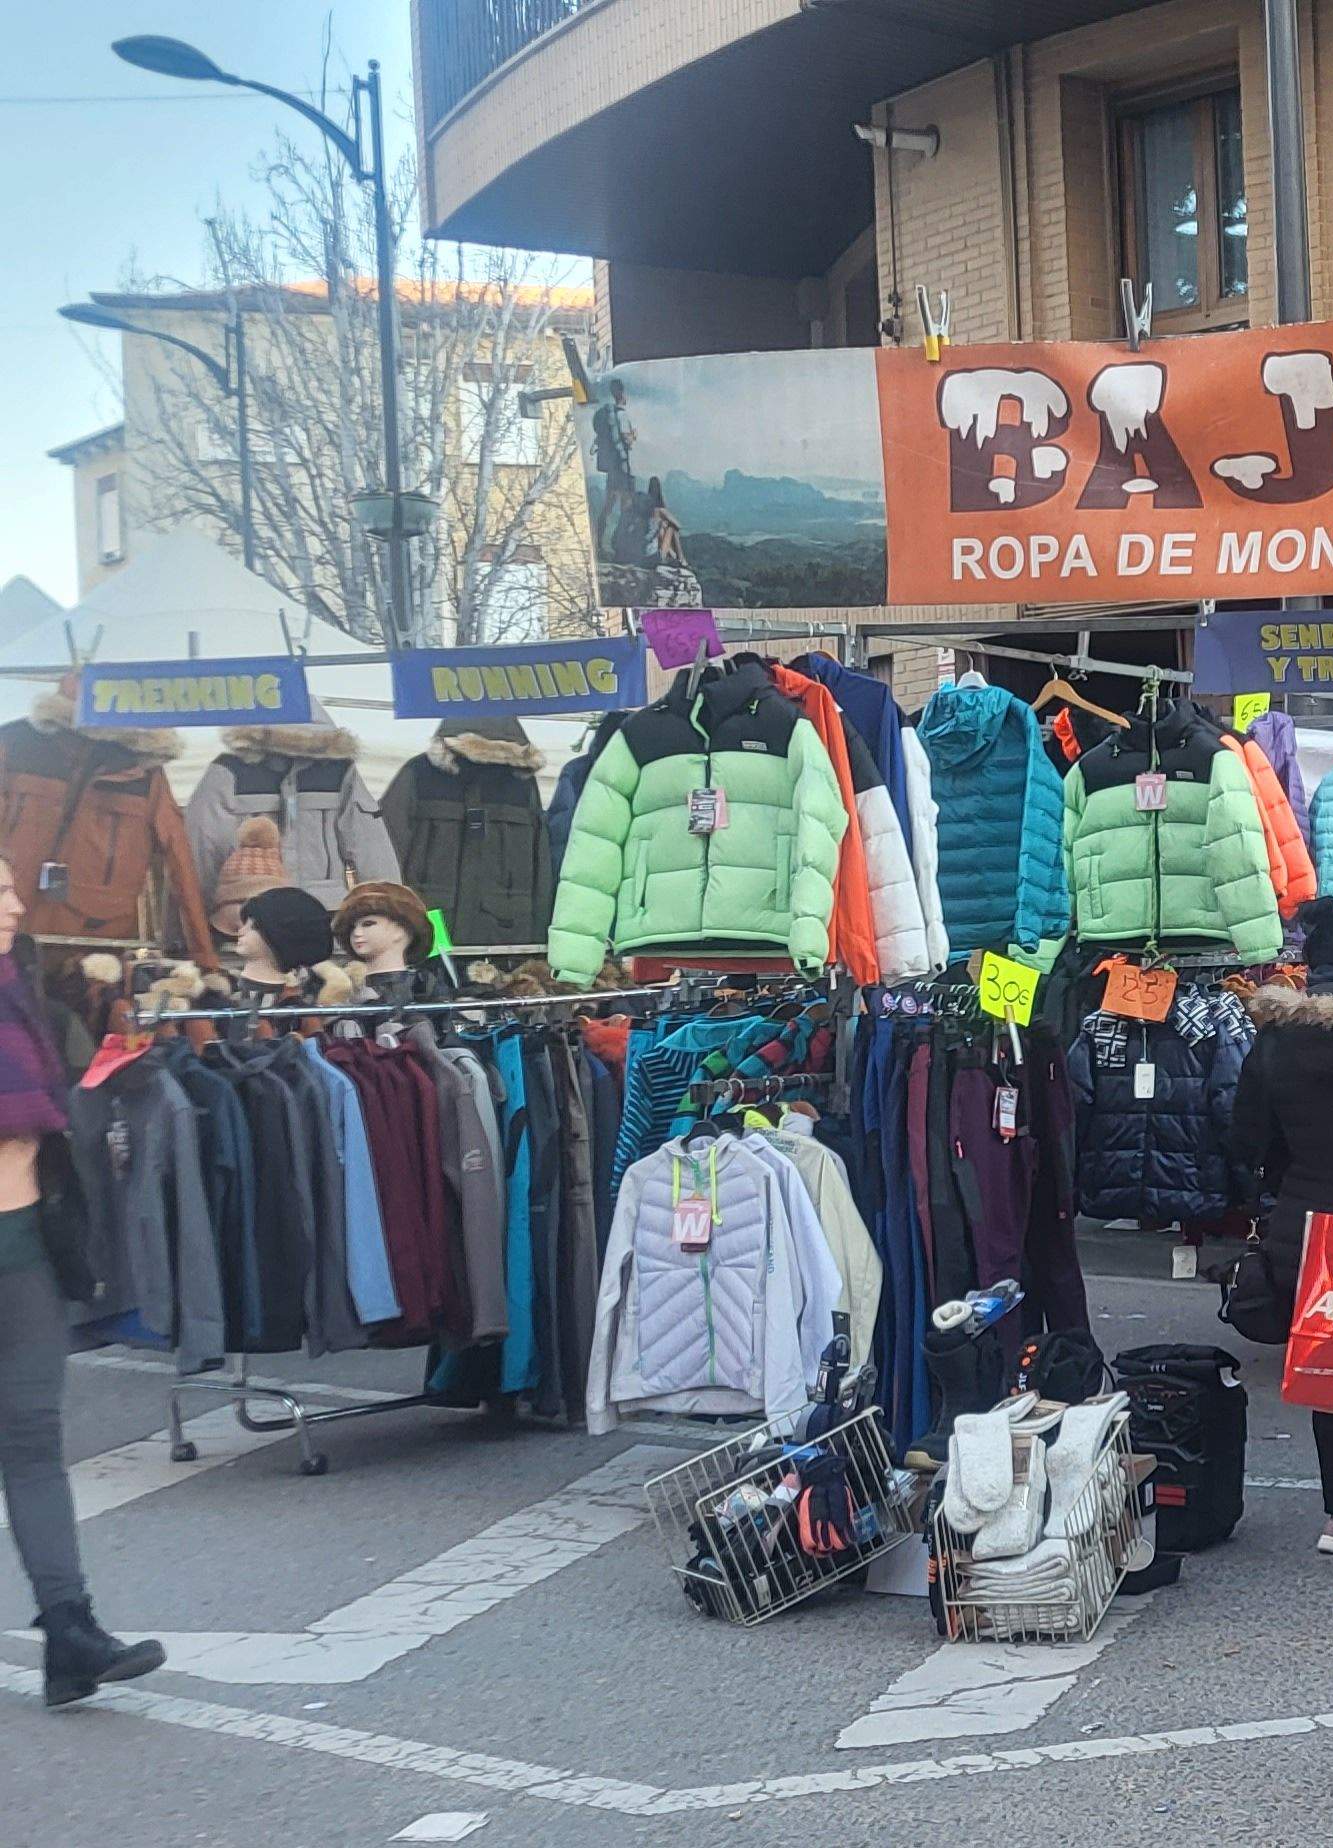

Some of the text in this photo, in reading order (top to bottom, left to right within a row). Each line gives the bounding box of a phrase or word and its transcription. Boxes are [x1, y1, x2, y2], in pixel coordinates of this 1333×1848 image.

[952, 534, 1098, 580] ROPA
[1117, 533, 1198, 576] DE
[430, 657, 619, 702] RUNNING
[1267, 656, 1291, 683] Y
[92, 673, 283, 713] TREKKING
